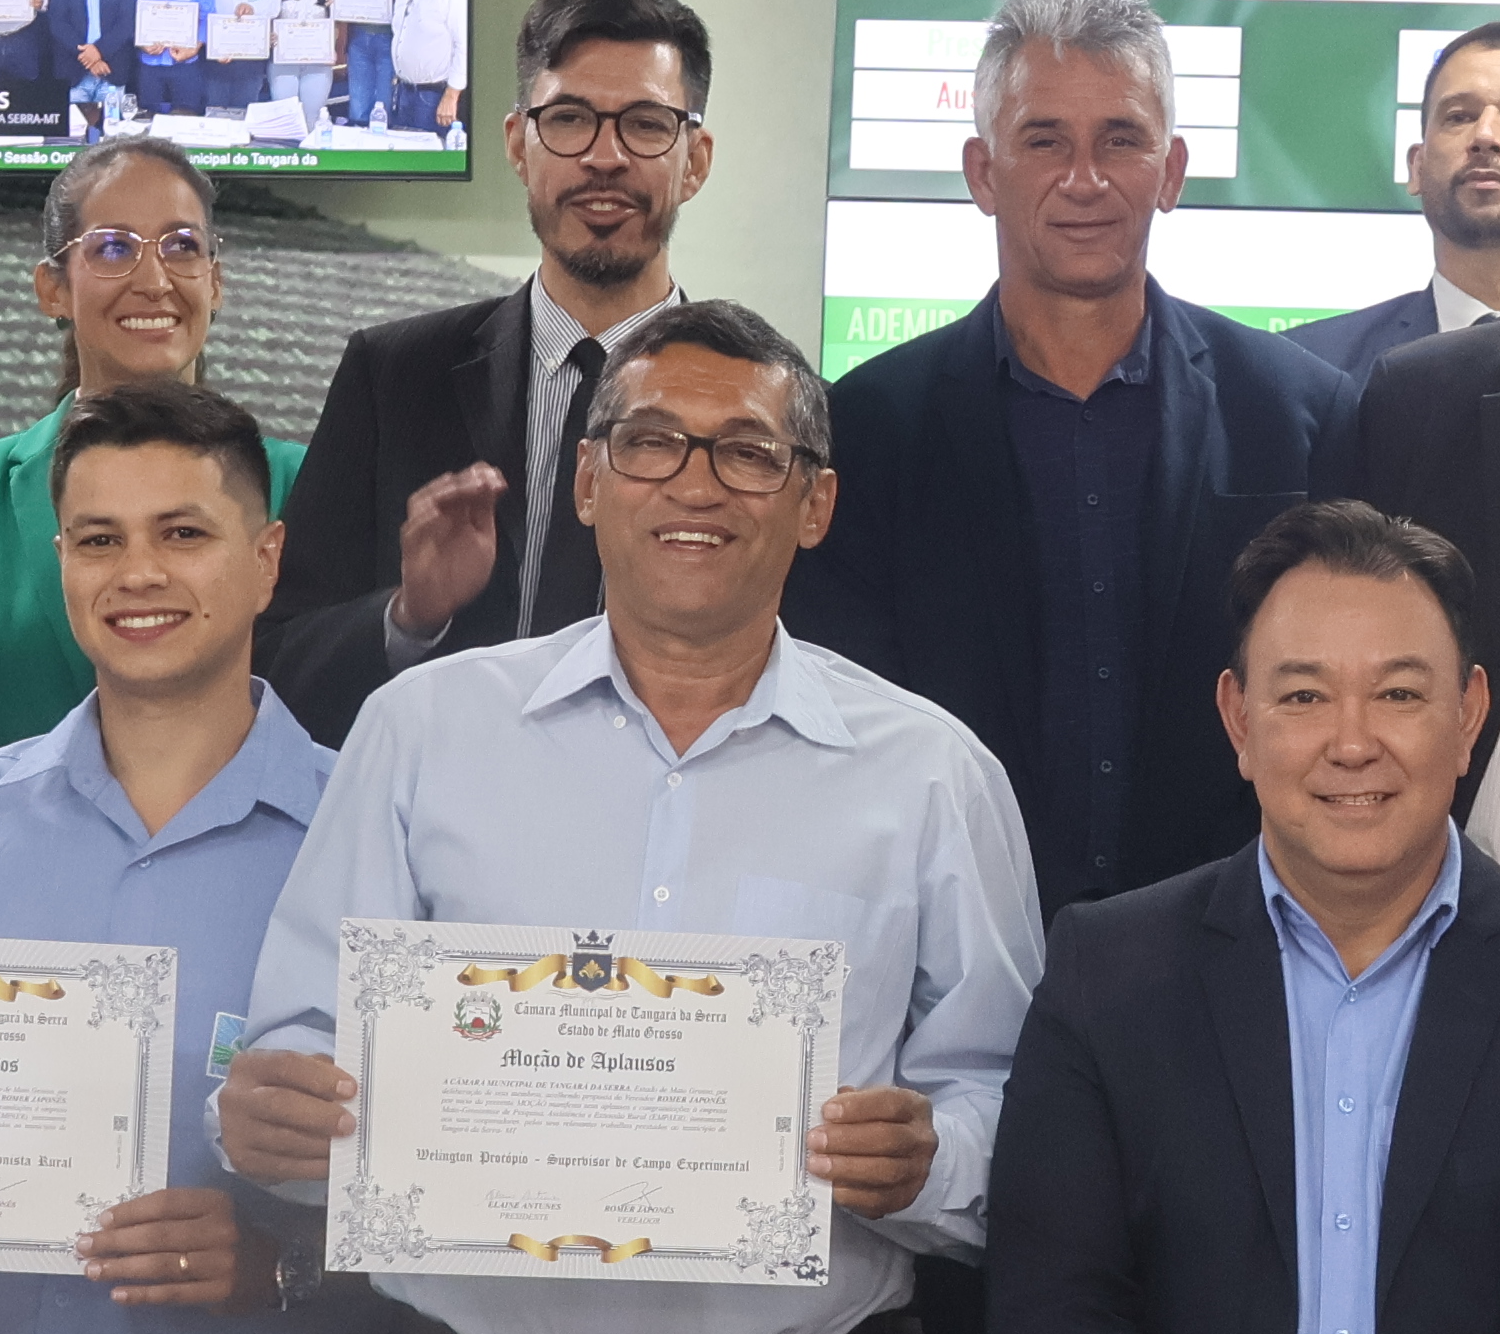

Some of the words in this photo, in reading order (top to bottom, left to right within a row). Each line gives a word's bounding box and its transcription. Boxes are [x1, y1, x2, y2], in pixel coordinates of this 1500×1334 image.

[8, 113, 60, 124] SERRA-MT
[4, 151, 48, 165] Sessão
[233, 153, 248, 166] de
[251, 152, 299, 169] Tangará
[302, 153, 317, 166] da
[514, 1000, 555, 1016] Câmara
[559, 1004, 612, 1020] Municipal
[616, 1007, 627, 1019] de
[631, 1006, 676, 1023] Tangará
[680, 1009, 691, 1021] da
[695, 1008, 726, 1023] Serra
[501, 1048, 559, 1072] Moção
[567, 1052, 585, 1069] de
[592, 1051, 675, 1073] Aplausos
[547, 1153, 610, 1168] Supervisor
[616, 1156, 627, 1168] de
[633, 1156, 670, 1171] Campo
[677, 1158, 749, 1173] Experimental
